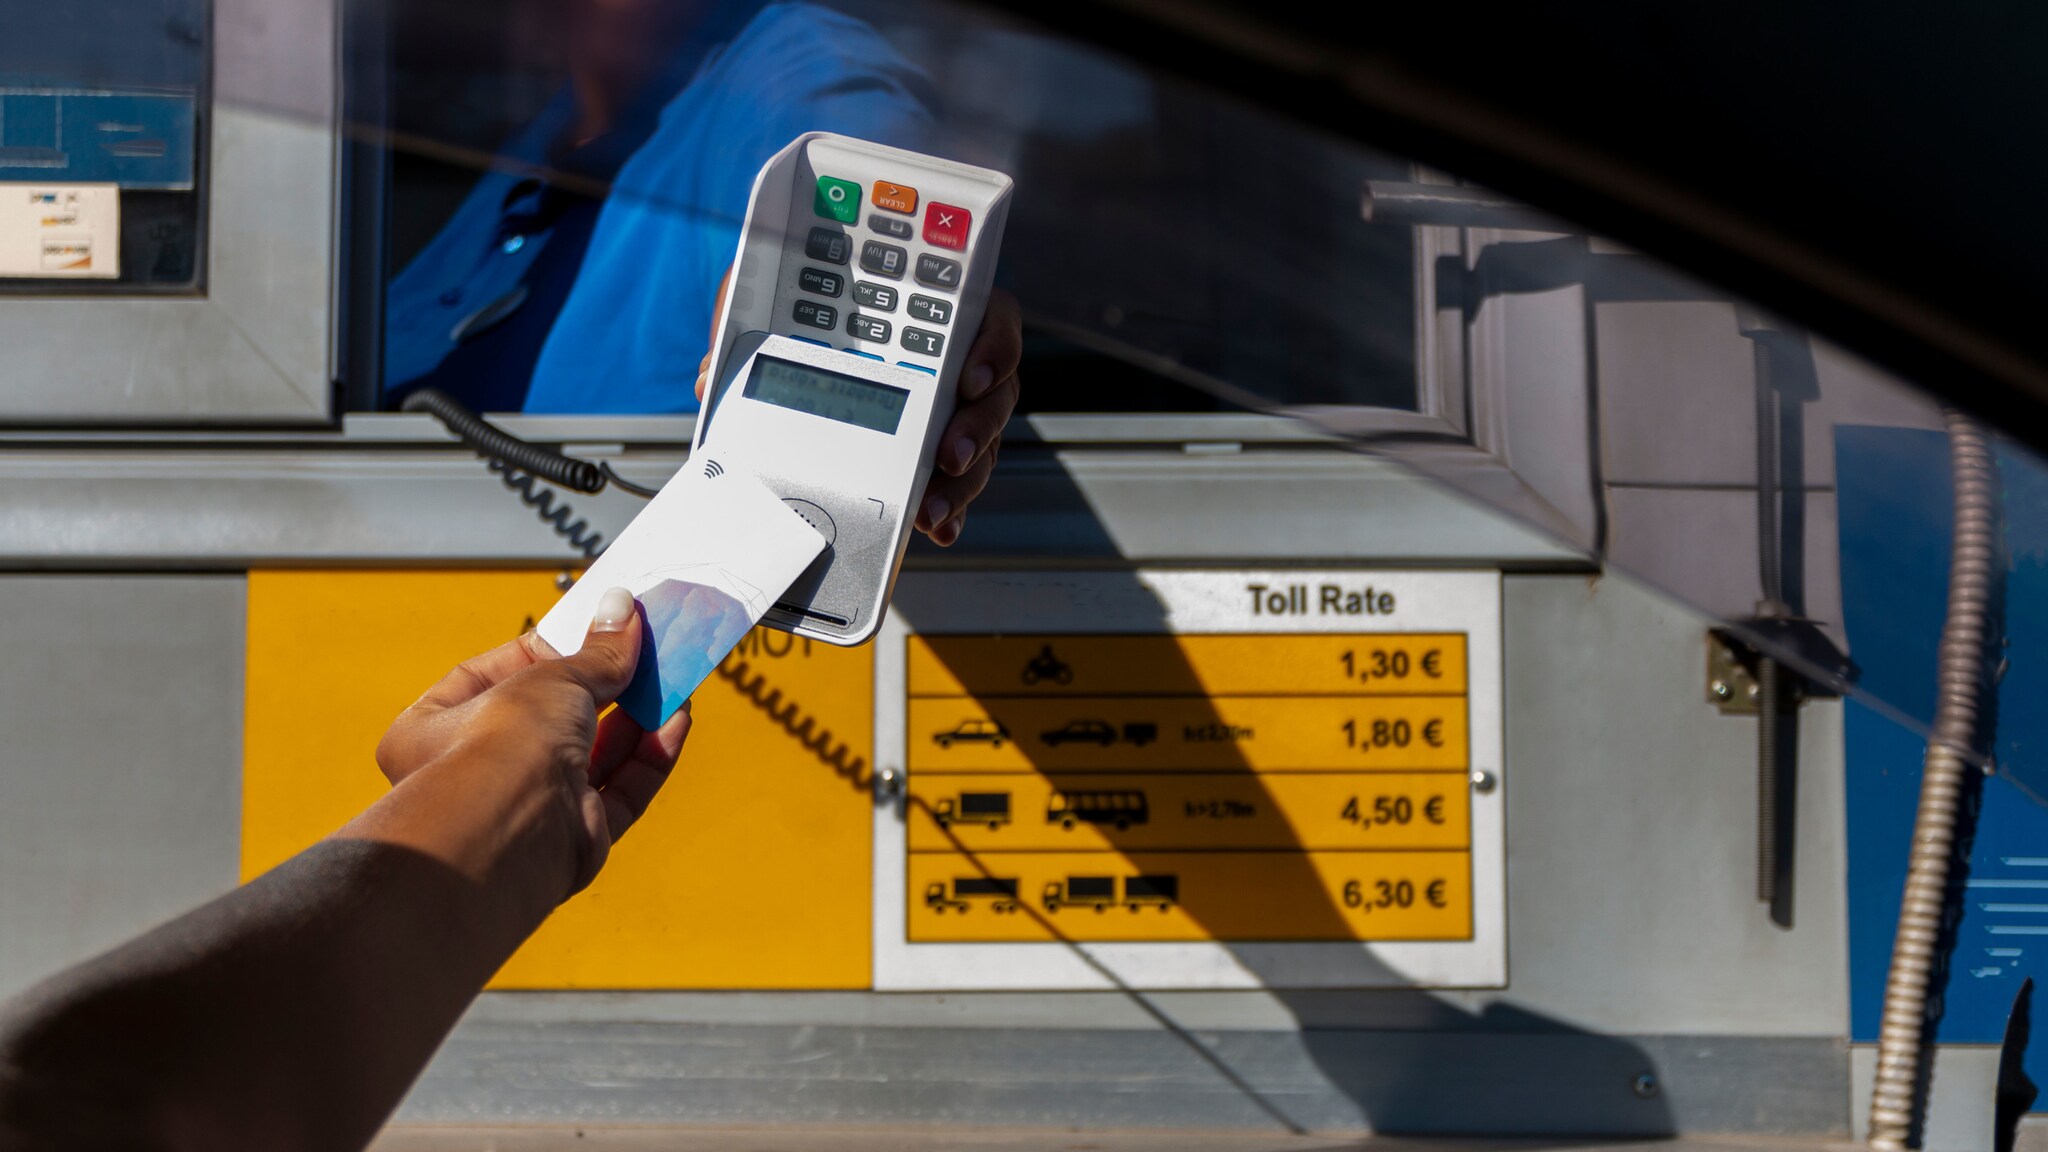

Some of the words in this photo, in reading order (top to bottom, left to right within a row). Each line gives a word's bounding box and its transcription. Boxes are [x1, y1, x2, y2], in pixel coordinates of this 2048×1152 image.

[880, 196, 905, 209] CLEAR
[867, 246, 883, 258] TUV
[804, 273, 822, 284] MNO
[938, 265, 952, 281] 7
[821, 278, 836, 293] 6
[859, 286, 874, 296] JKL
[875, 291, 890, 307] 5
[914, 299, 929, 309] GHI
[798, 305, 814, 315] DEF
[815, 310, 830, 326] 3
[929, 304, 944, 320] 4
[854, 317, 869, 328] ABC
[869, 322, 884, 339] 2
[927, 337, 936, 351] 1
[1247, 584, 1307, 615] Toll
[1320, 584, 1395, 616] Rate
[1340, 649, 1410, 684] 1,30
[1421, 649, 1443, 679] €
[1341, 718, 1412, 753] 1,80
[1422, 718, 1444, 748] €
[1341, 795, 1413, 830] 4,50
[1424, 795, 1445, 825] €
[1343, 879, 1414, 914] 6,30
[1425, 879, 1447, 909] €
